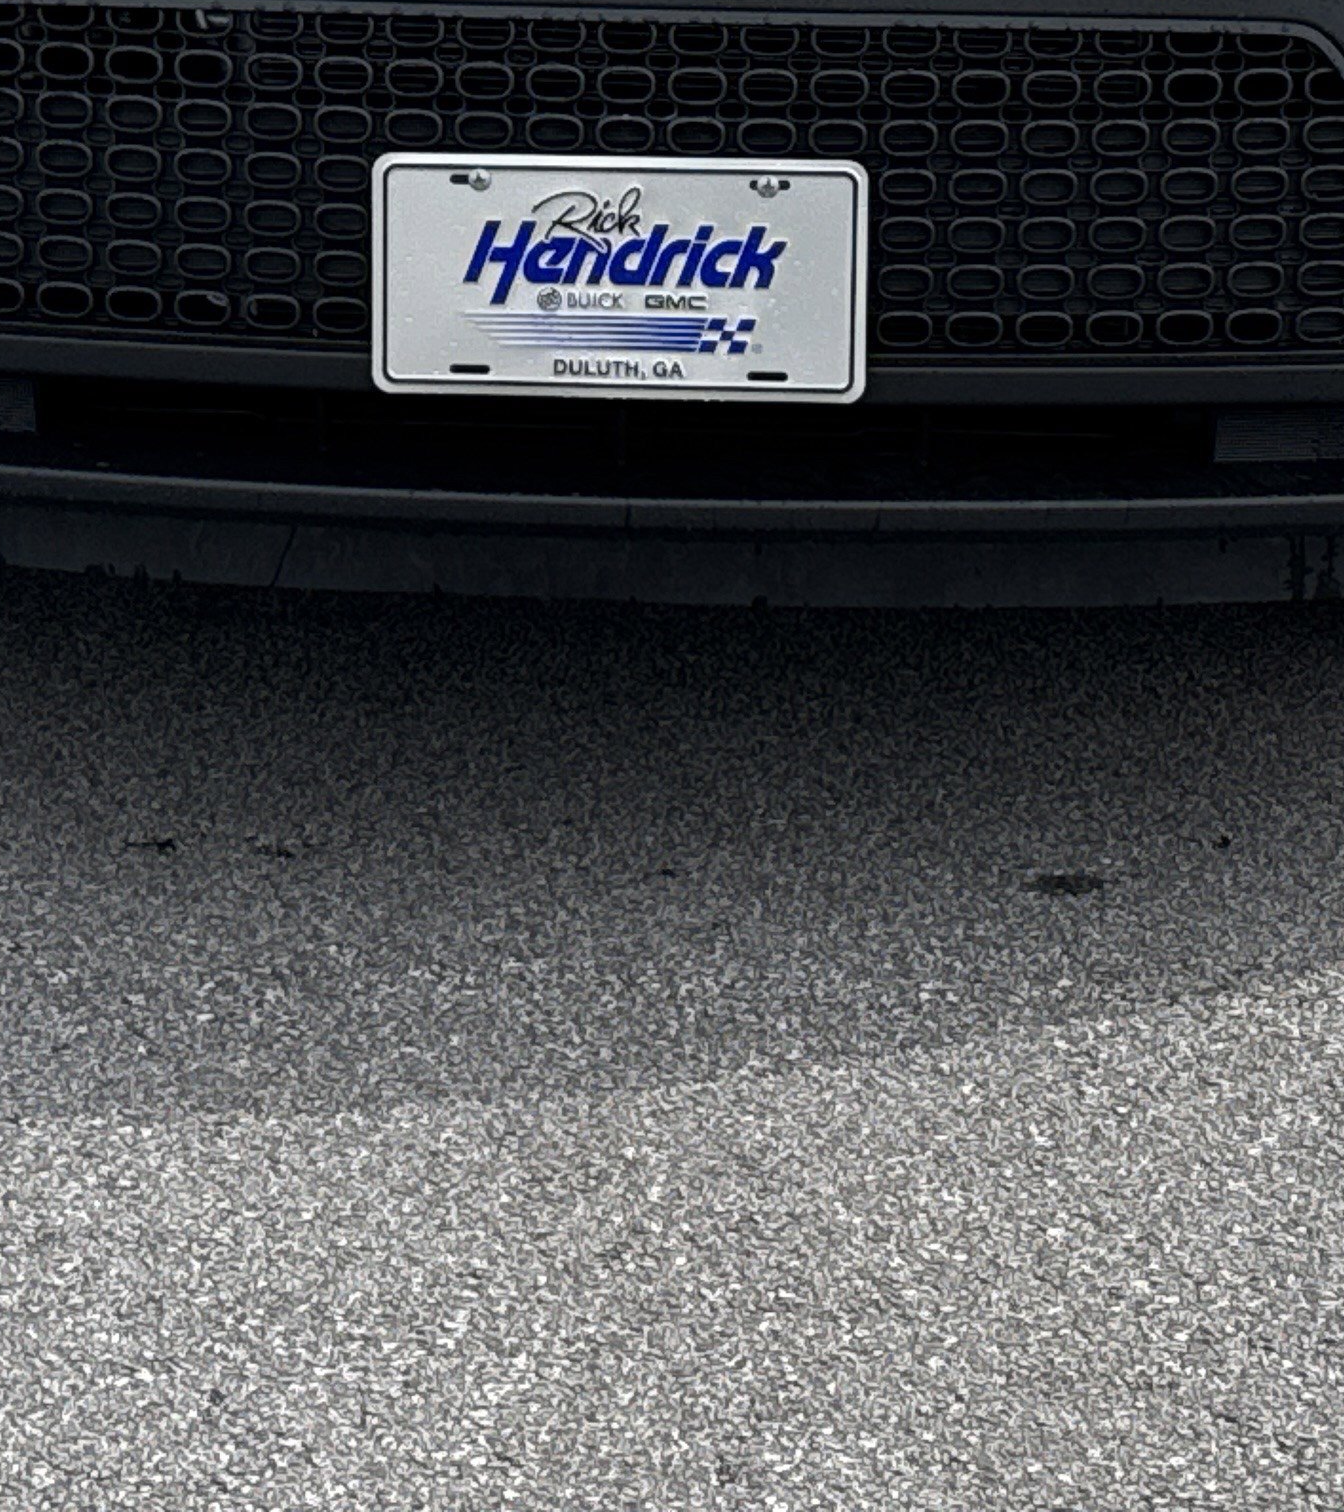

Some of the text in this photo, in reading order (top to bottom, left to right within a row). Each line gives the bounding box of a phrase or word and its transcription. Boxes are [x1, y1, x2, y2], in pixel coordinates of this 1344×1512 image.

[531, 186, 643, 251] Rick
[462, 219, 788, 305] Hendrick
[567, 292, 708, 311] BUICK GMC
[553, 358, 684, 380] DULUTH, GA
